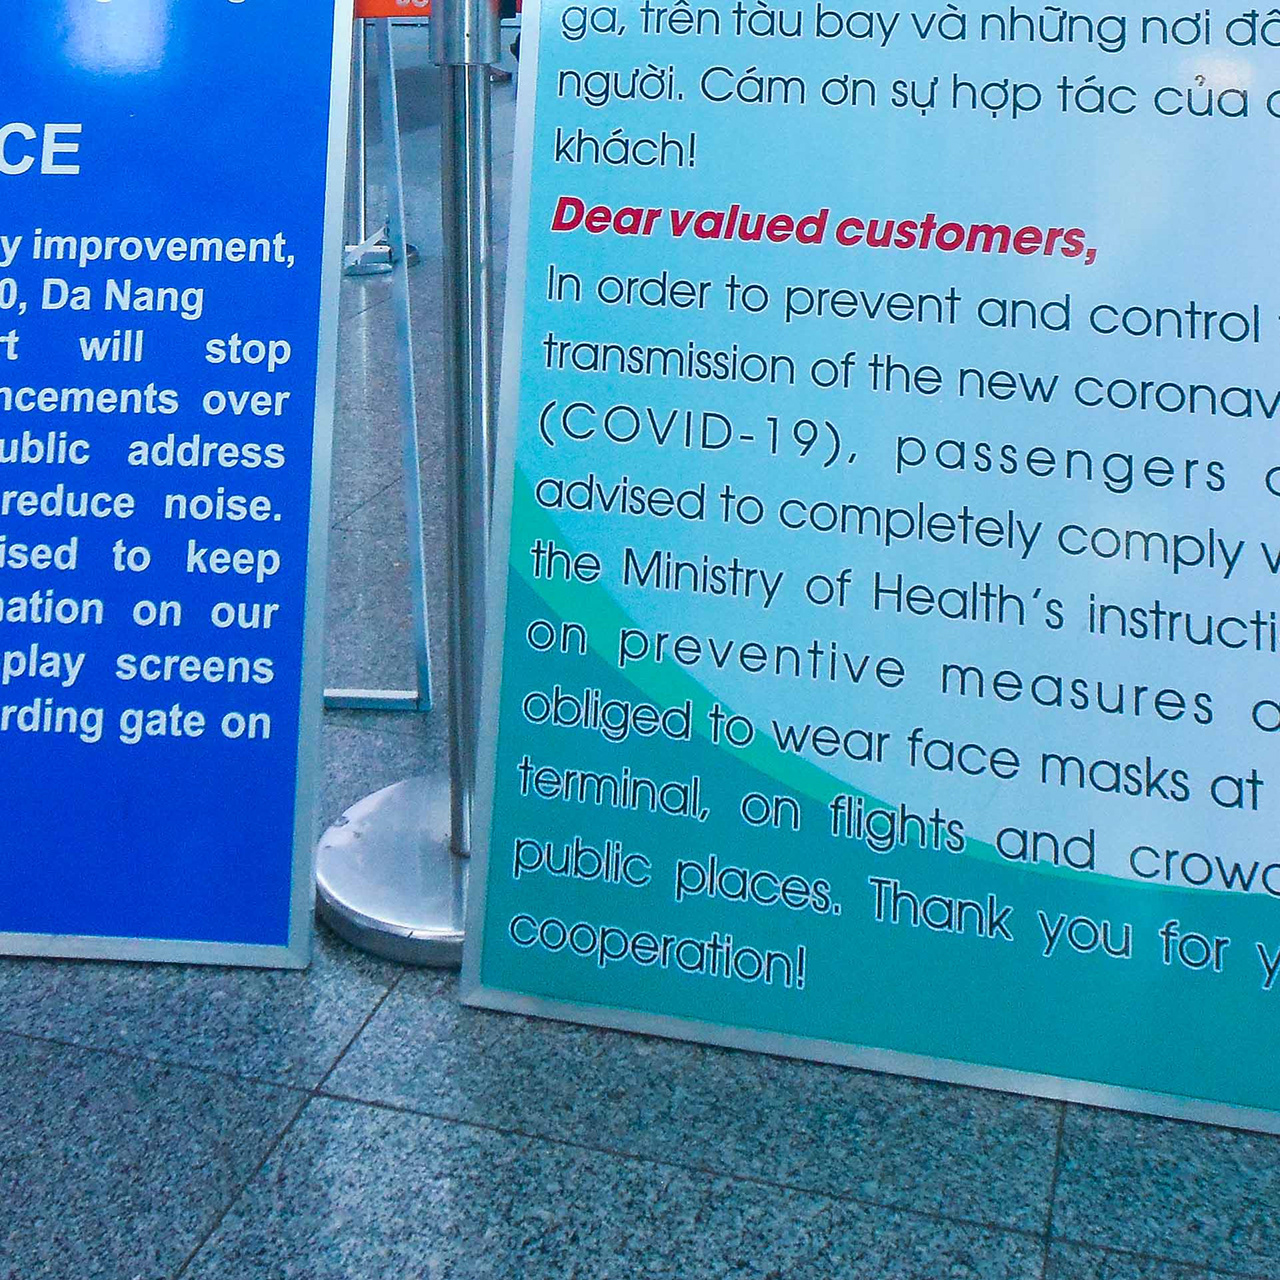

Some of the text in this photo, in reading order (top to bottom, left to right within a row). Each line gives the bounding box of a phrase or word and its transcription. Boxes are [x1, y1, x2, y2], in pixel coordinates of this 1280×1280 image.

[33, 228, 294, 268] improvement,
[552, 197, 1097, 265] Dear valued customers,
[42, 278, 90, 310] Da
[105, 279, 203, 320] Nang
[549, 265, 580, 301] In
[598, 271, 711, 308] order
[726, 275, 768, 312] to
[786, 287, 961, 323] prevent
[978, 294, 1070, 331] and
[1090, 301, 1259, 342] control
[544, 333, 794, 384] transmission
[811, 352, 855, 388] of
[868, 354, 942, 394] the
[960, 369, 1059, 402] new
[120, 704, 205, 744] gate
[221, 712, 270, 738] on
